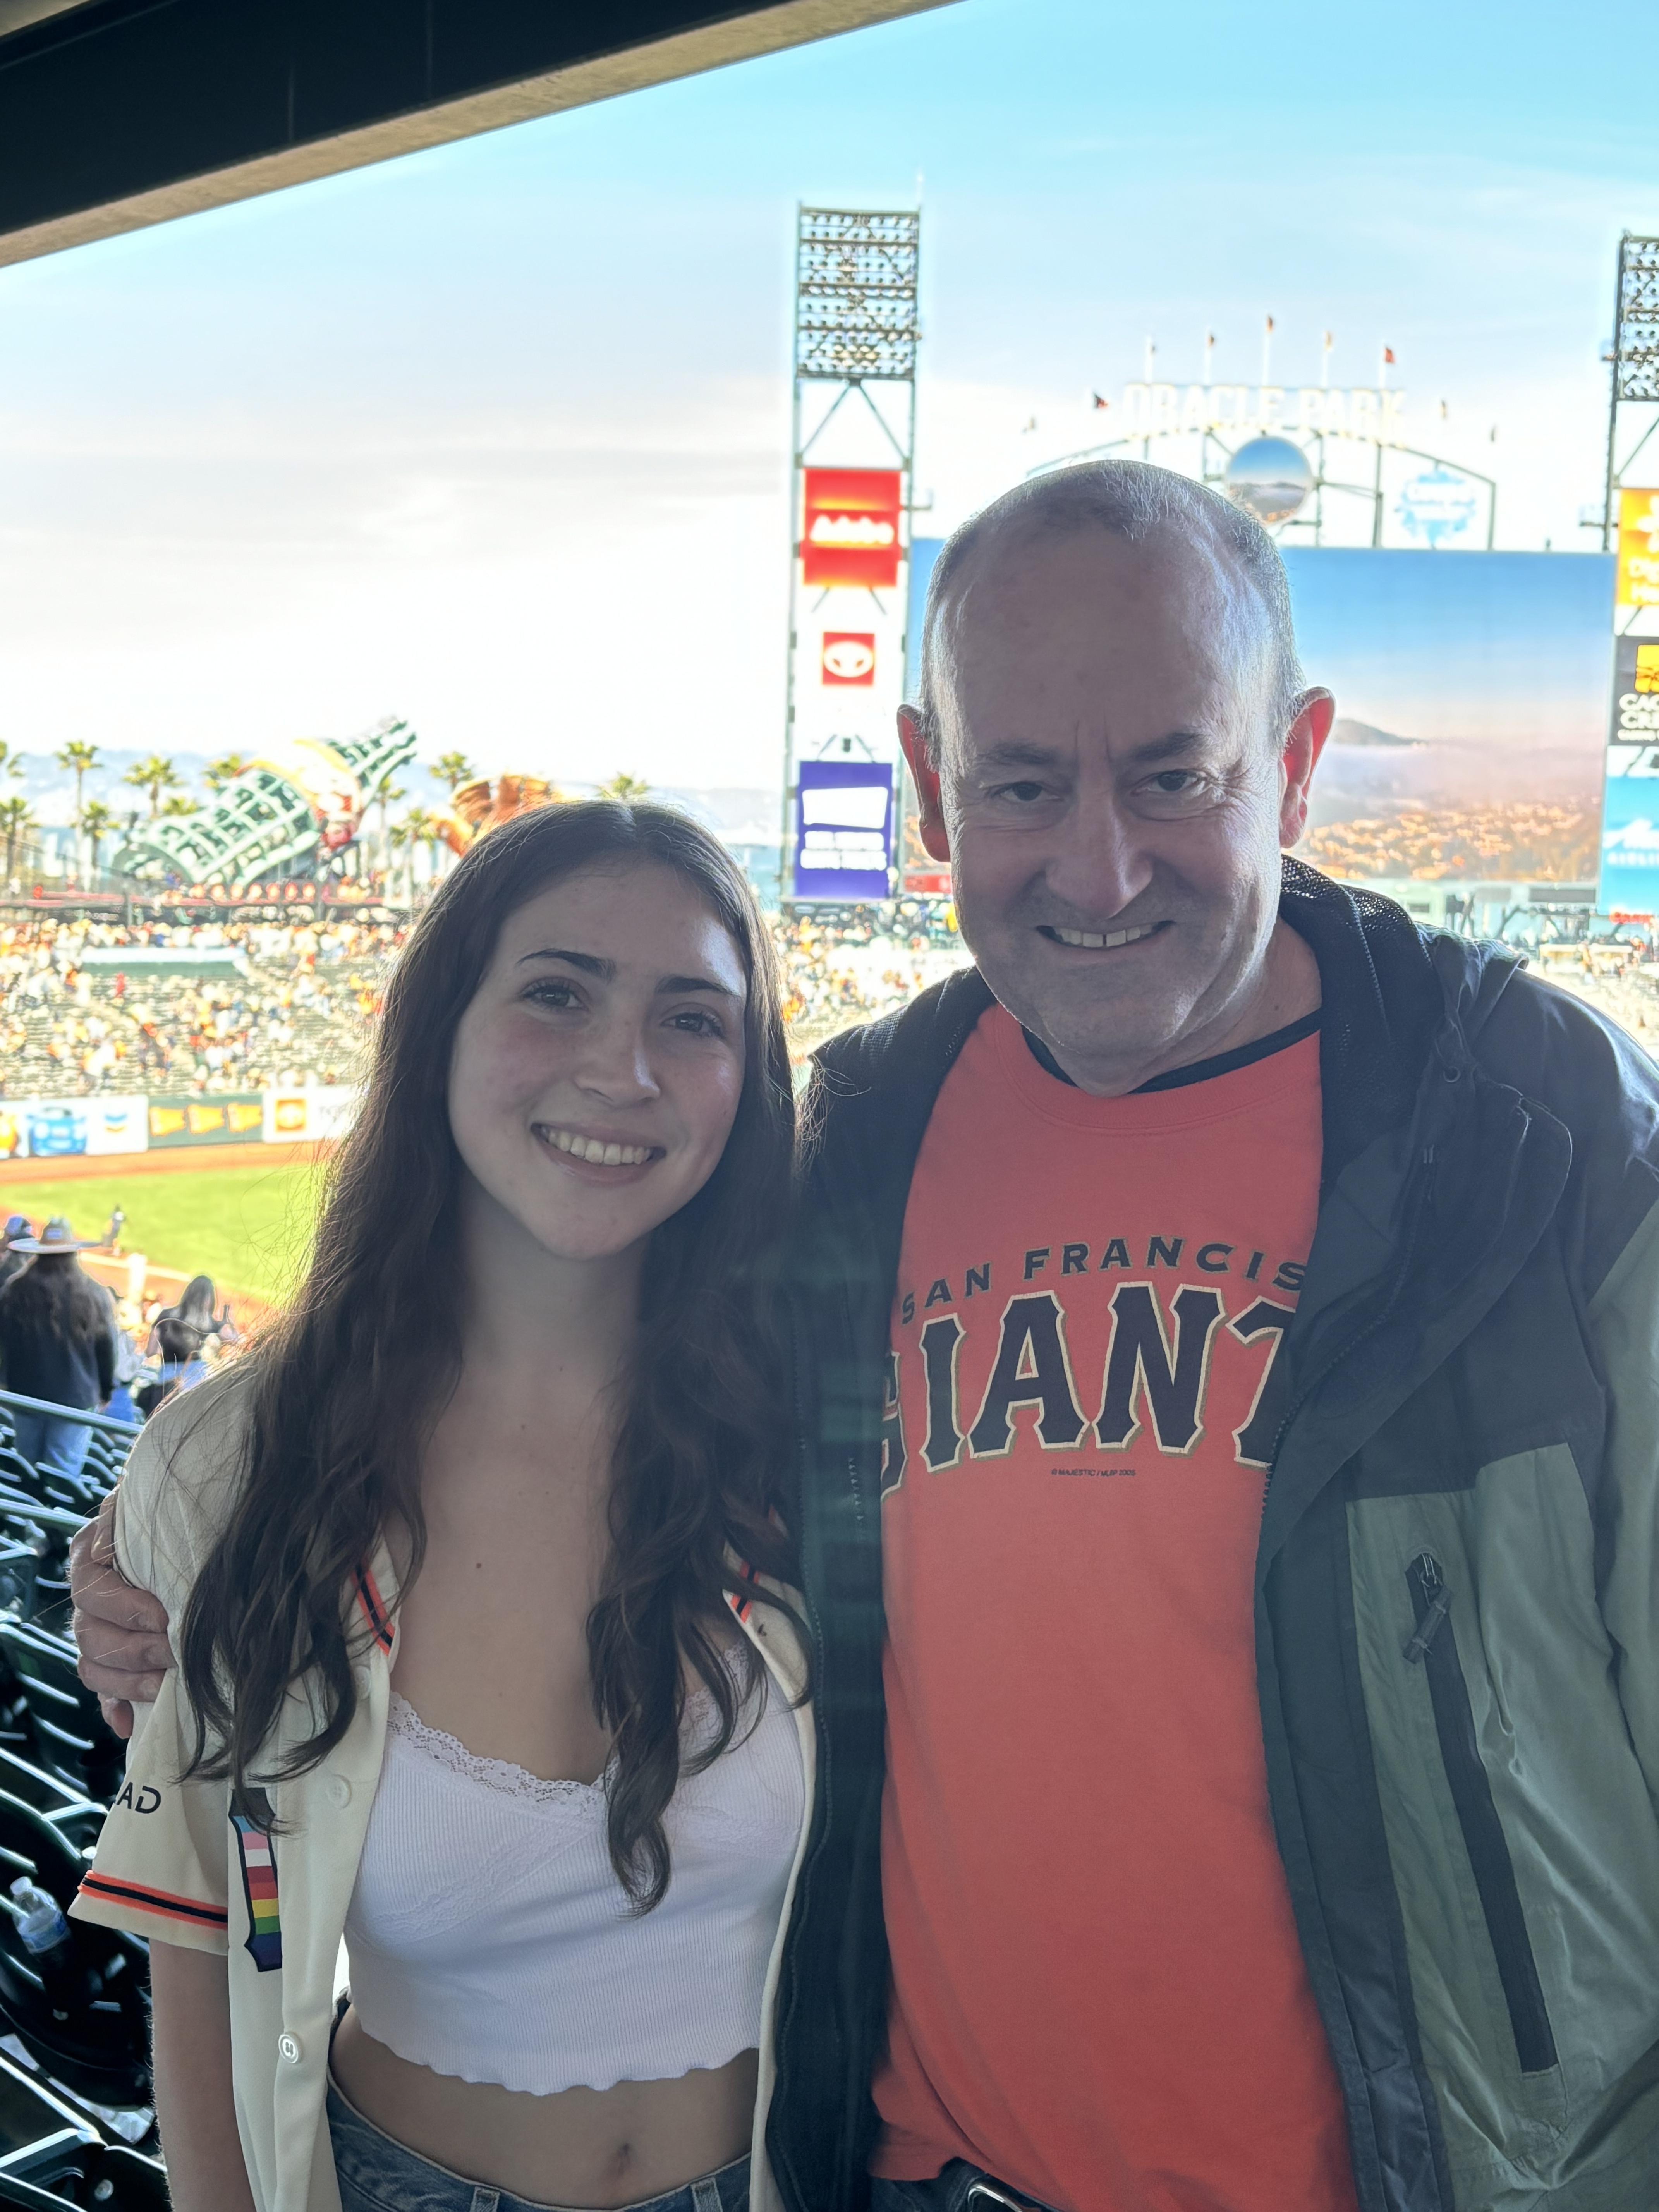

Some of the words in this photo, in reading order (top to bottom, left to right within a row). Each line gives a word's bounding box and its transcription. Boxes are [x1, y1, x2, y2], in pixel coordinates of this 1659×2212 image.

[1121, 384, 1286, 431] ORACLE
[1299, 387, 1407, 436] PARK
[902, 1262, 992, 1325] SAN
[1023, 1235, 1307, 1293] FRANCIS
